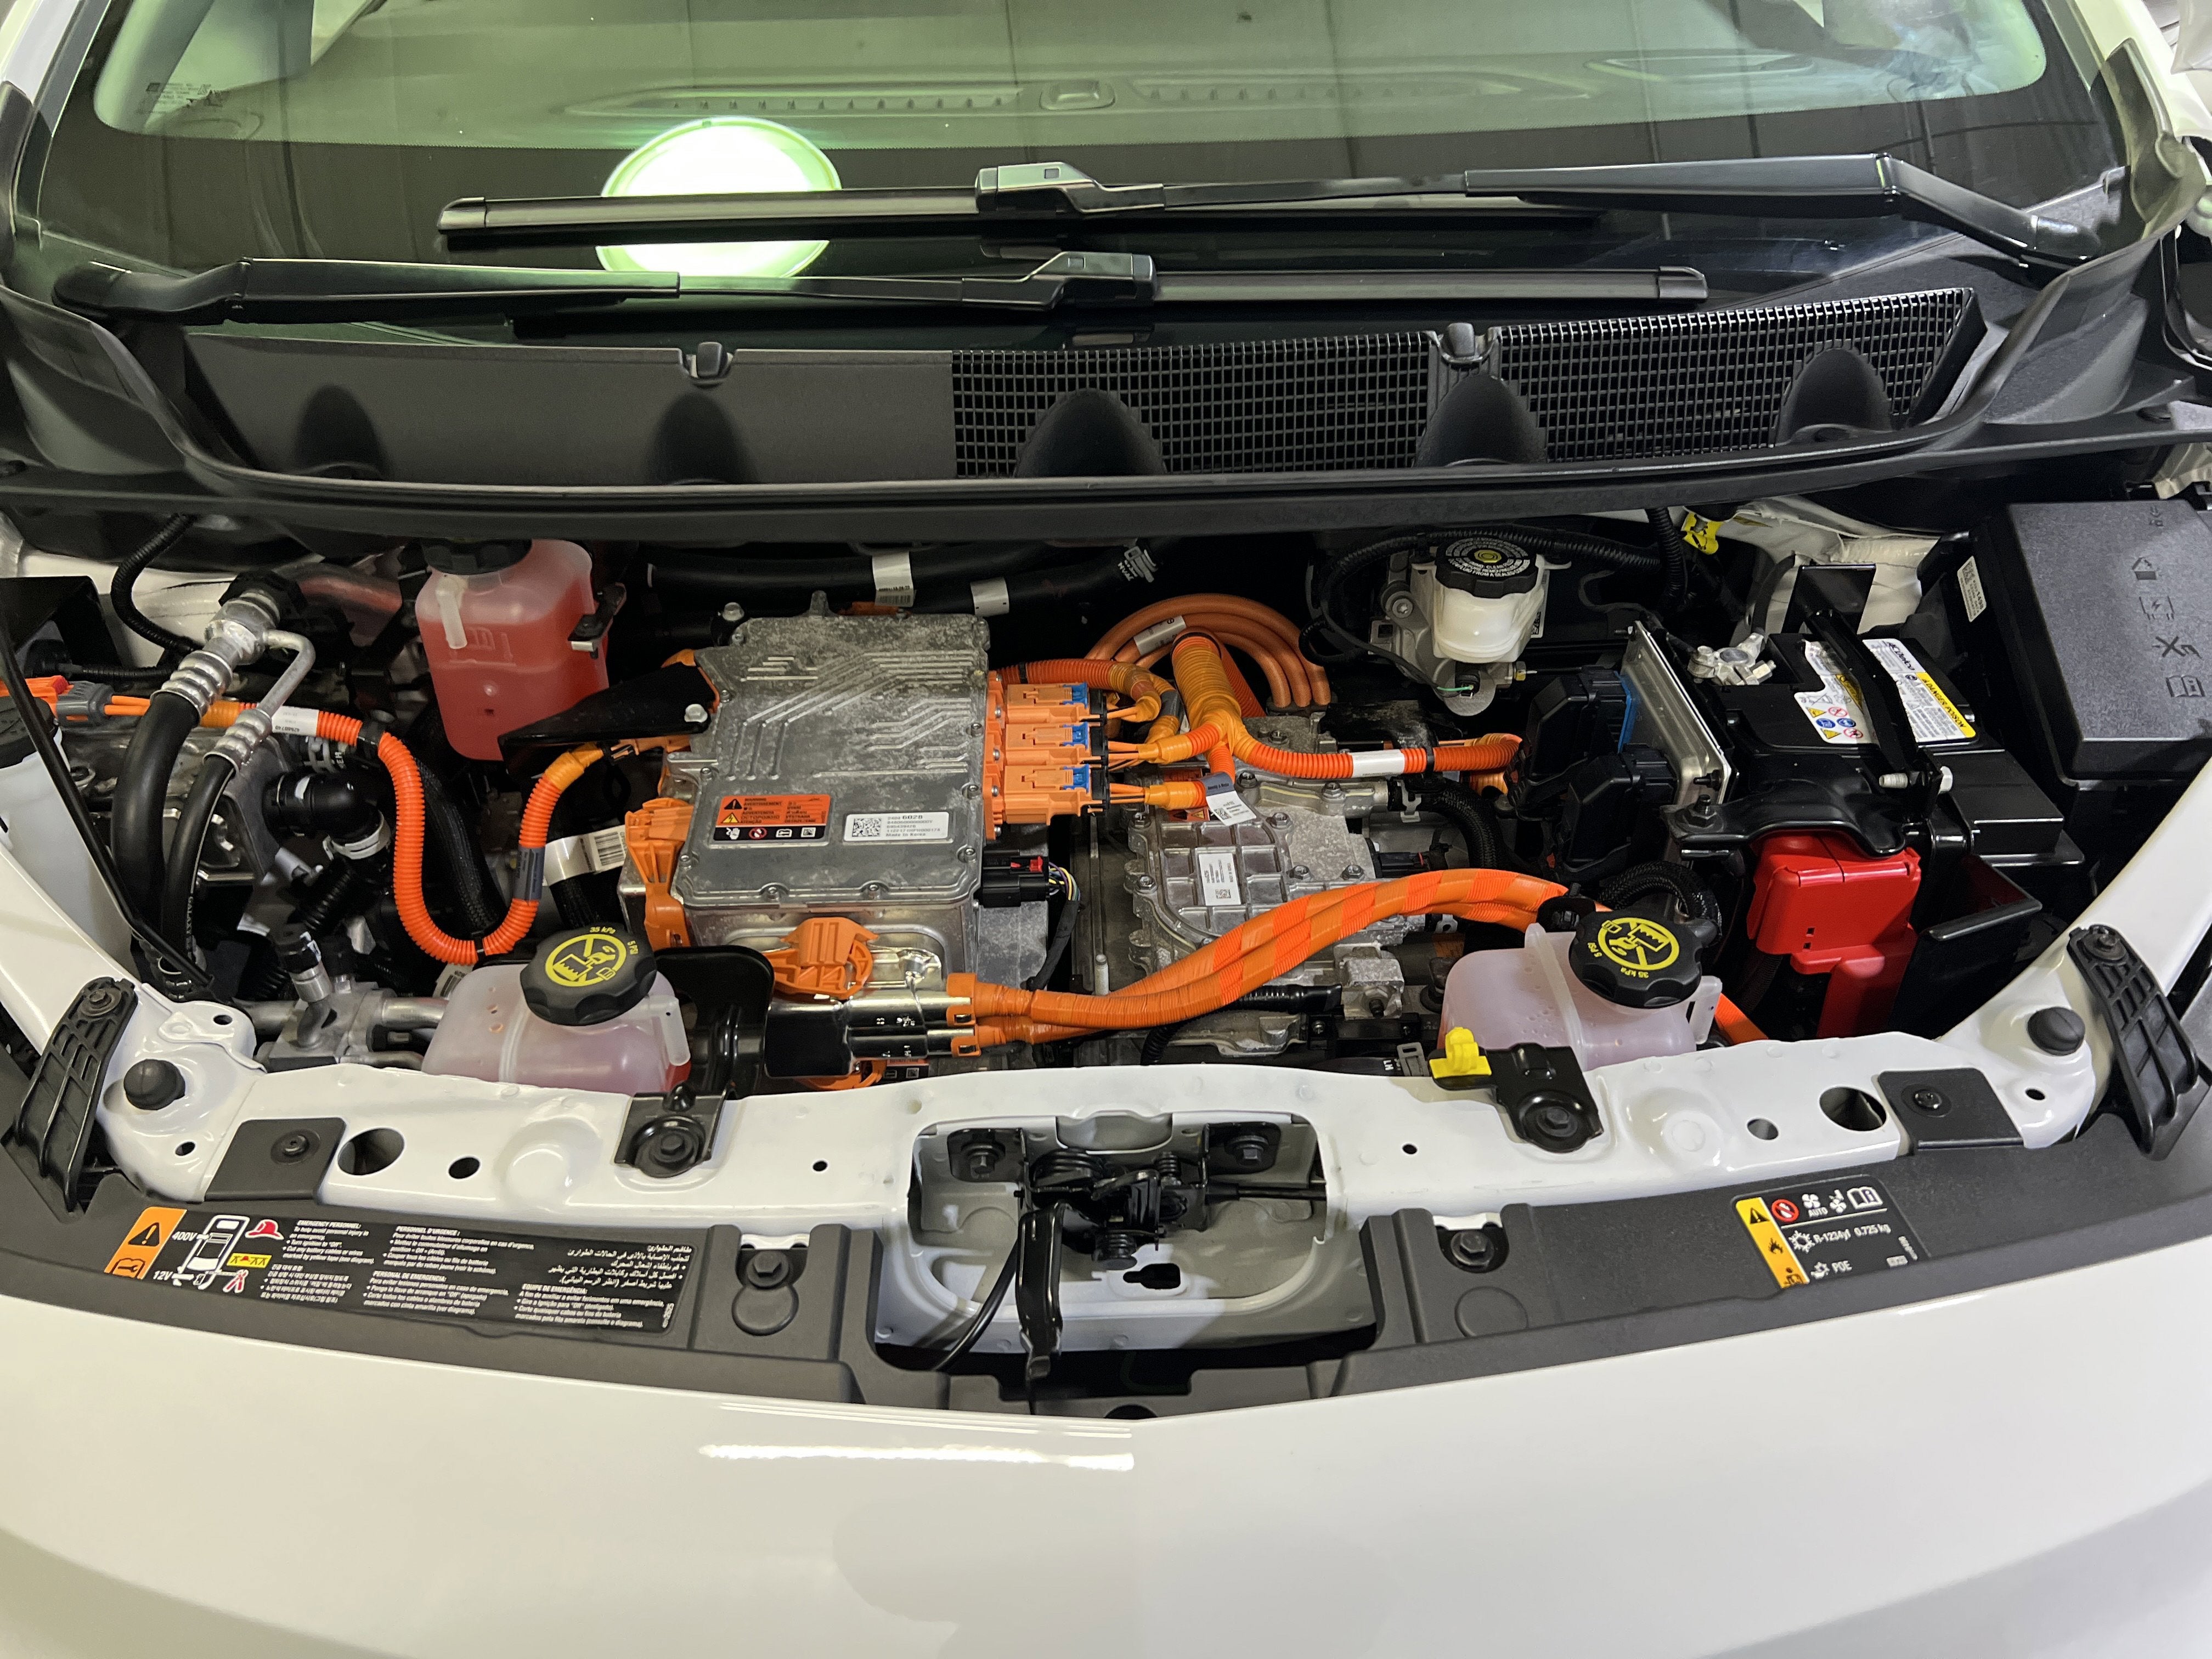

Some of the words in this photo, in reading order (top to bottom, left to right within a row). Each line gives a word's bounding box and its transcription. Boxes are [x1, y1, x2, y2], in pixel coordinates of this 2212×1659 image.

[1620, 967, 1637, 978] kPa
[1808, 1207, 1829, 1218] AUTO
[172, 1231, 198, 1242] 400V
[1813, 1228, 1852, 1244] R-1234yf
[1877, 1223, 1892, 1234] kg
[1831, 1260, 1853, 1273] POE
[153, 1271, 173, 1280] 12V
